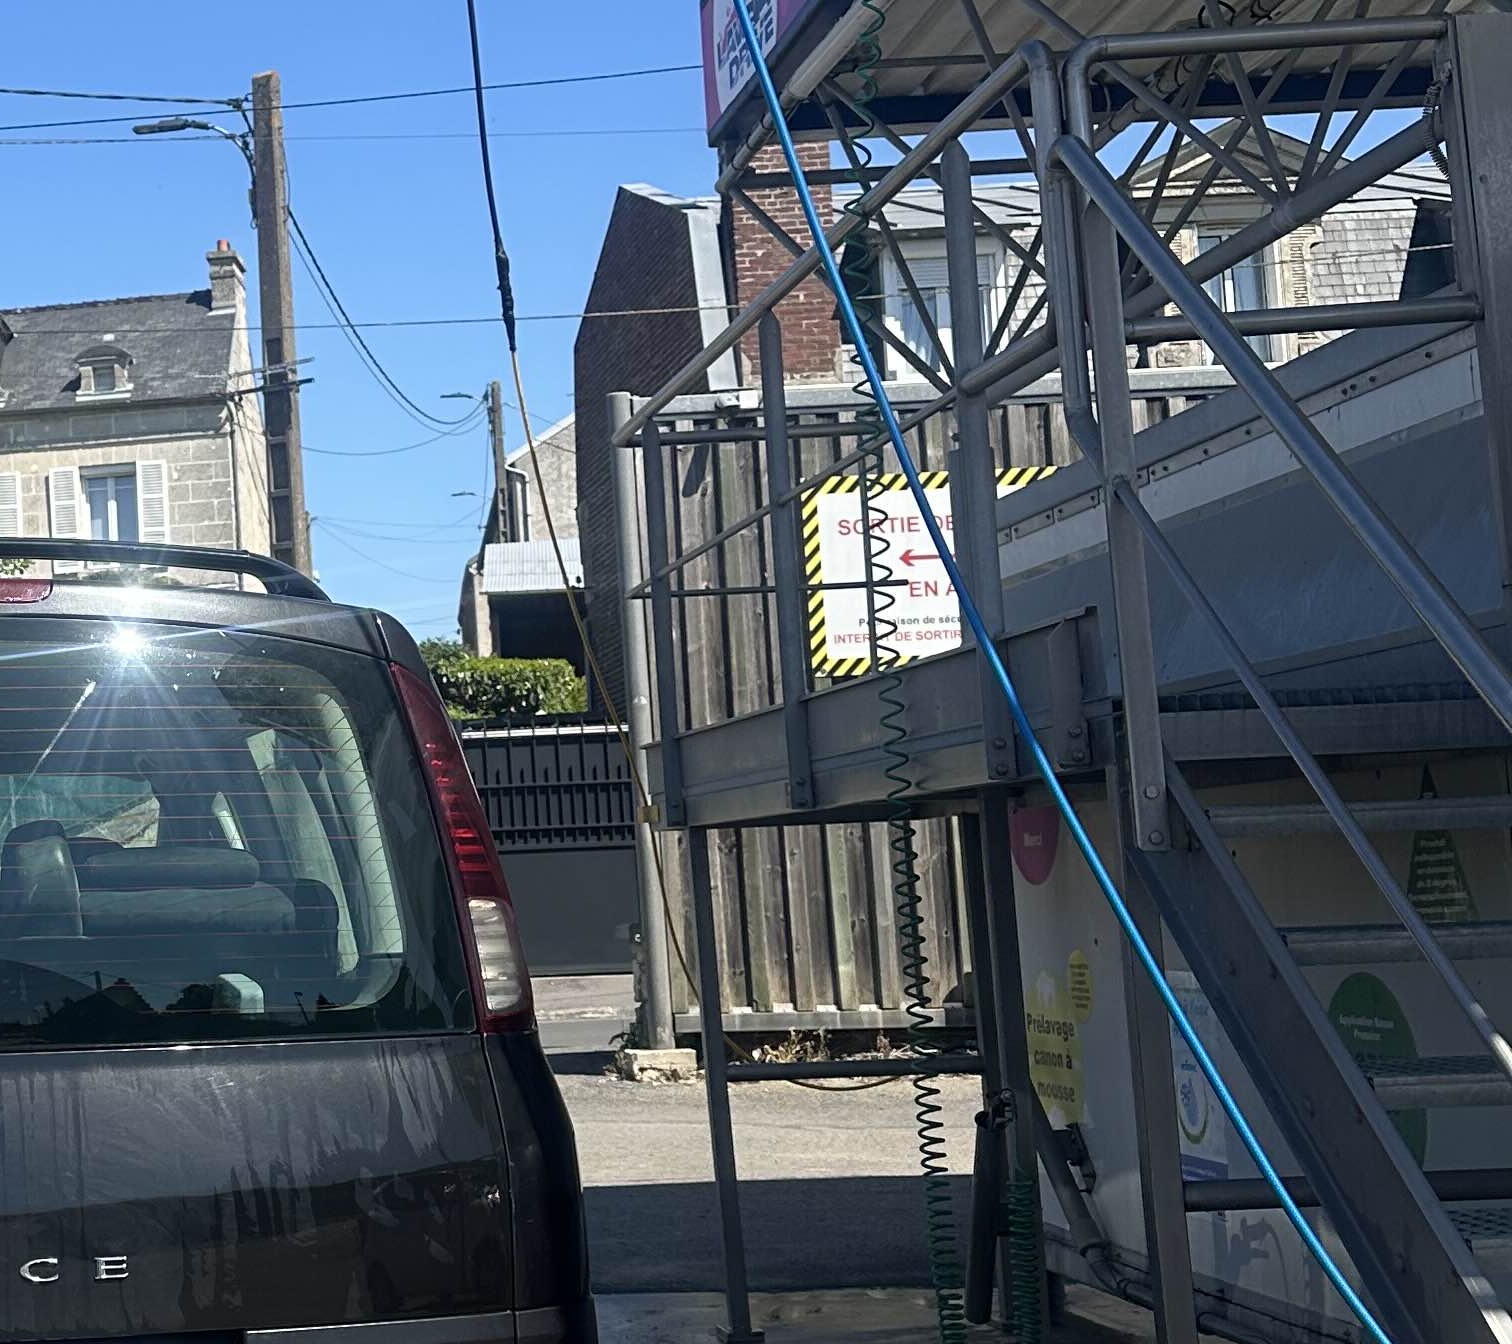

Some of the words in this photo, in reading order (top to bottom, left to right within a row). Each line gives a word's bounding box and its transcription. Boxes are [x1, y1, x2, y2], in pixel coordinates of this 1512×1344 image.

[837, 516, 921, 536] SORTIE
[909, 581, 939, 597] EN
[922, 616, 936, 624] de
[894, 630, 913, 642] DE
